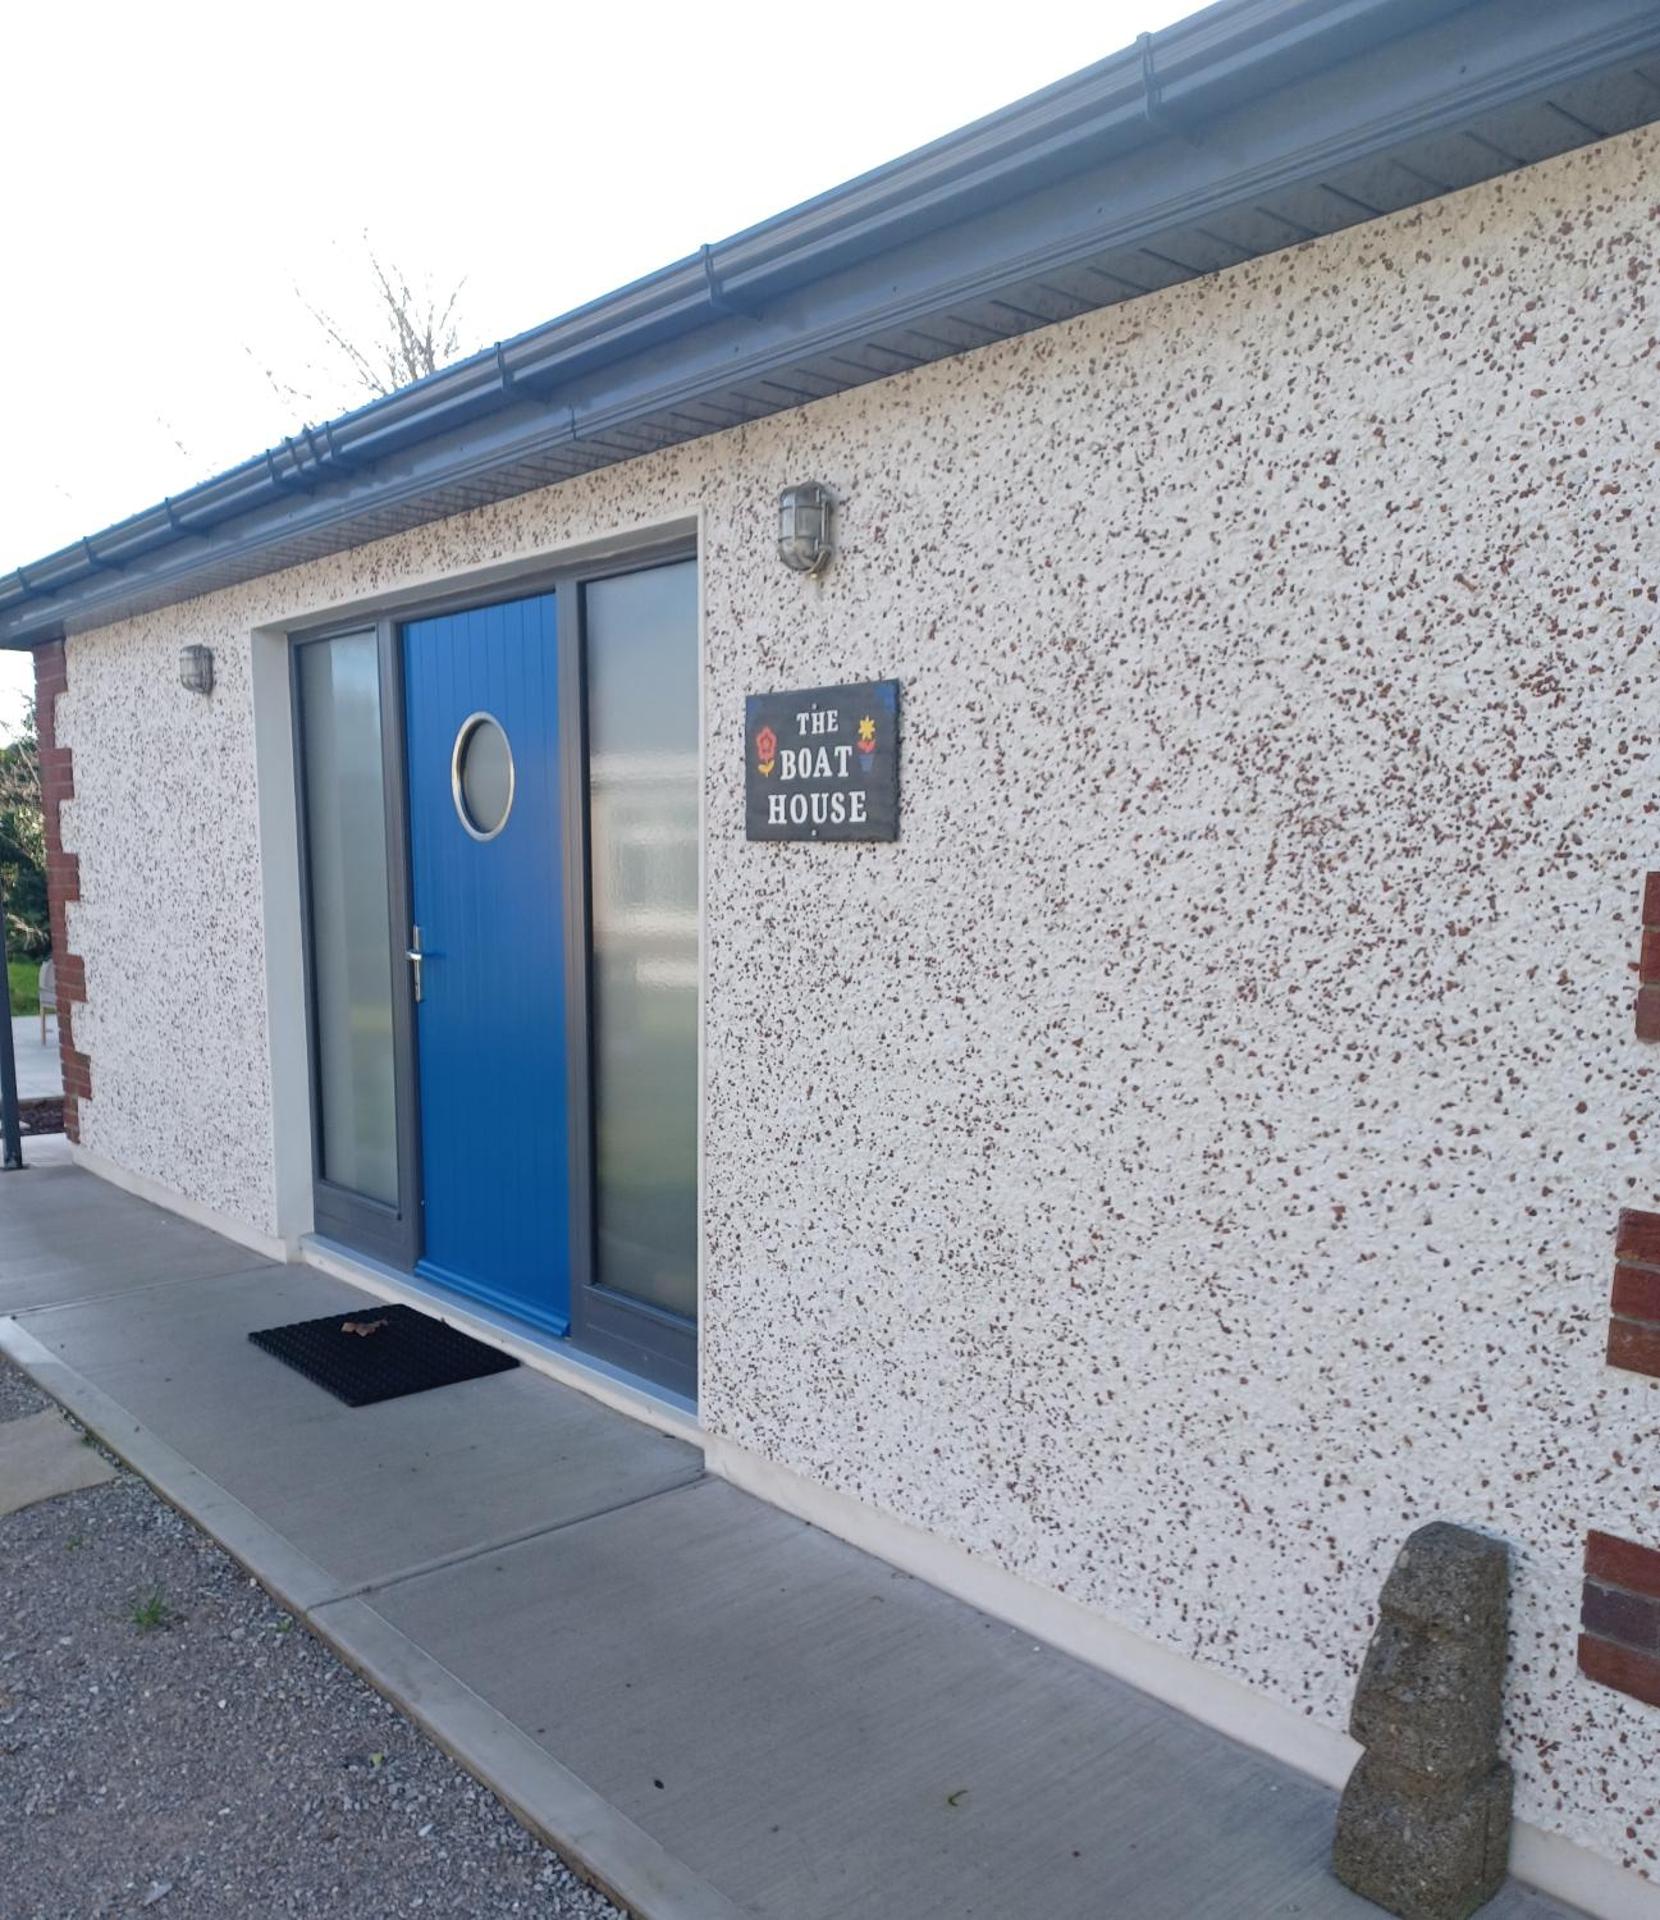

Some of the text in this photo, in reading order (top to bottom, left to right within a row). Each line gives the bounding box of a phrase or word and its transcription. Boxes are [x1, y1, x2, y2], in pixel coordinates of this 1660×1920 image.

[796, 710, 838, 735] THE
[780, 745, 852, 780] BOAT
[767, 791, 867, 825] HOUSE
